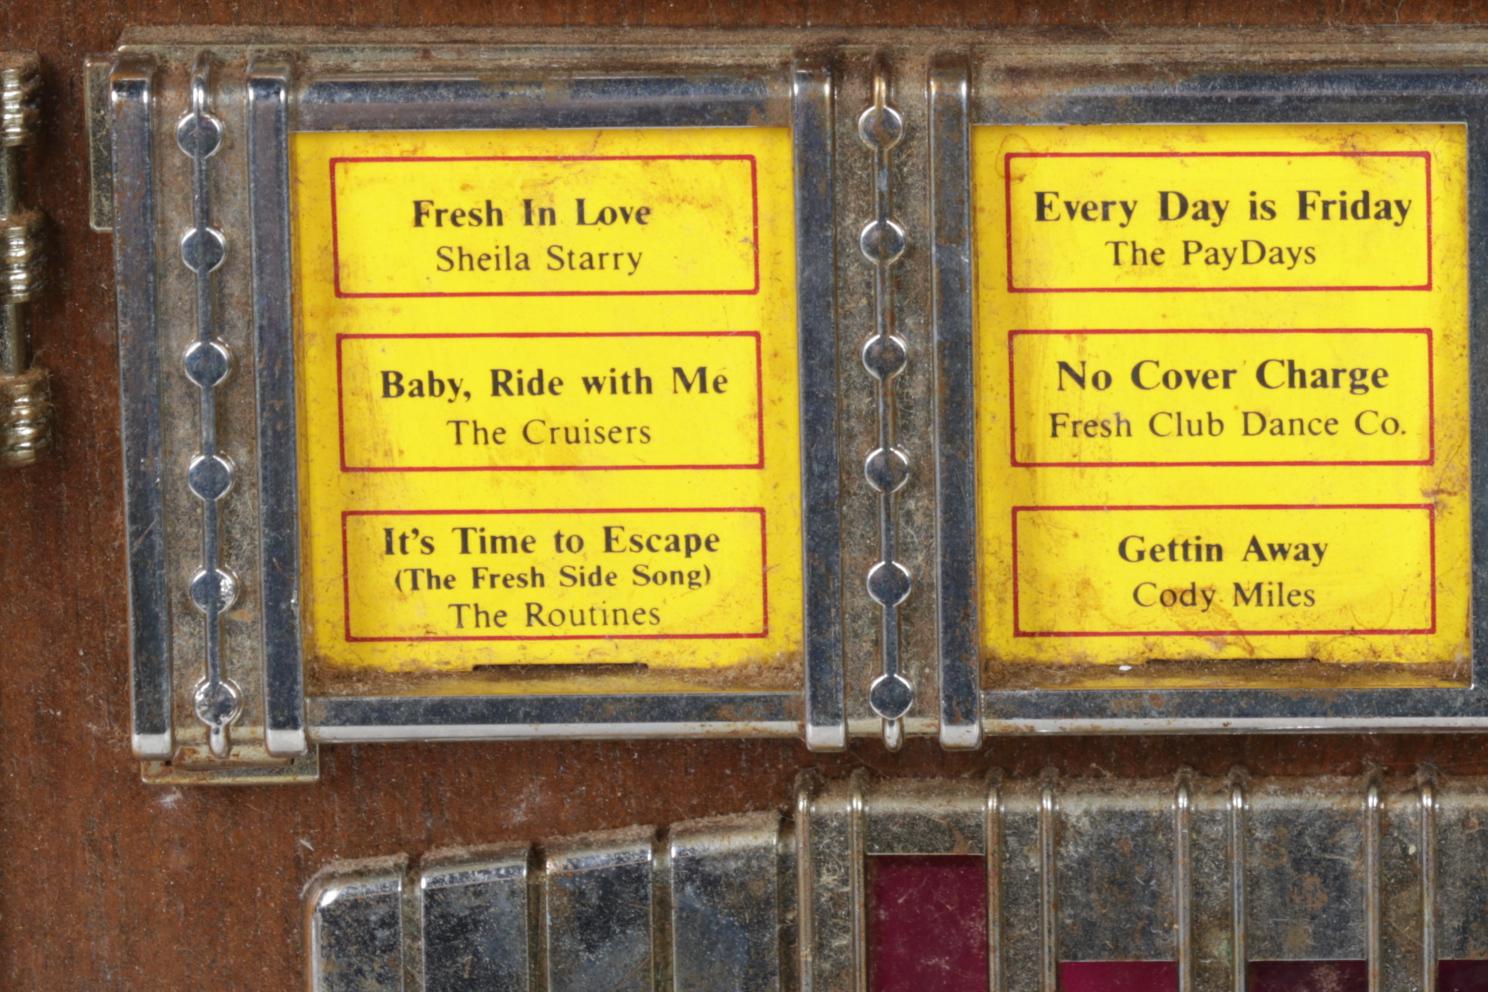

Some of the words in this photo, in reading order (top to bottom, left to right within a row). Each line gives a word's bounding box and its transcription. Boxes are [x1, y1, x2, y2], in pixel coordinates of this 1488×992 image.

[412, 199, 504, 228] Fresh
[522, 198, 557, 227] In
[575, 198, 651, 226] Love
[1034, 191, 1138, 229] Every
[1158, 190, 1230, 228] Day
[1249, 190, 1277, 221] is
[1297, 189, 1412, 228] Friday
[436, 245, 531, 272] Sheila
[546, 244, 642, 276] Starry
[1105, 240, 1166, 267] The
[1182, 239, 1316, 271] PayDays
[380, 369, 472, 404] Baby,
[490, 368, 564, 397] Ride
[581, 367, 653, 396] with
[672, 366, 728, 395] Me
[1056, 360, 1113, 392] No
[1130, 359, 1238, 391] Cover
[1255, 358, 1389, 395] Charge
[446, 419, 507, 446] The
[522, 419, 651, 445] Cruisers
[1049, 412, 1132, 439] Fresh
[1148, 411, 1225, 438] Club
[1242, 411, 1339, 437] Dance
[1354, 410, 1406, 436] Co.
[383, 527, 435, 556] It's
[451, 526, 537, 555] Time
[553, 530, 585, 554] to
[602, 525, 720, 559] Escape
[1117, 535, 1224, 563] Gettin
[1242, 535, 1328, 568] Away
[394, 567, 457, 593] (The
[471, 566, 545, 590] Fresh
[559, 565, 618, 588] Side
[632, 564, 711, 590] Song)
[1132, 581, 1217, 613] Cody
[1233, 581, 1316, 608] Miles
[448, 602, 508, 629] The
[525, 602, 661, 628] Routines
